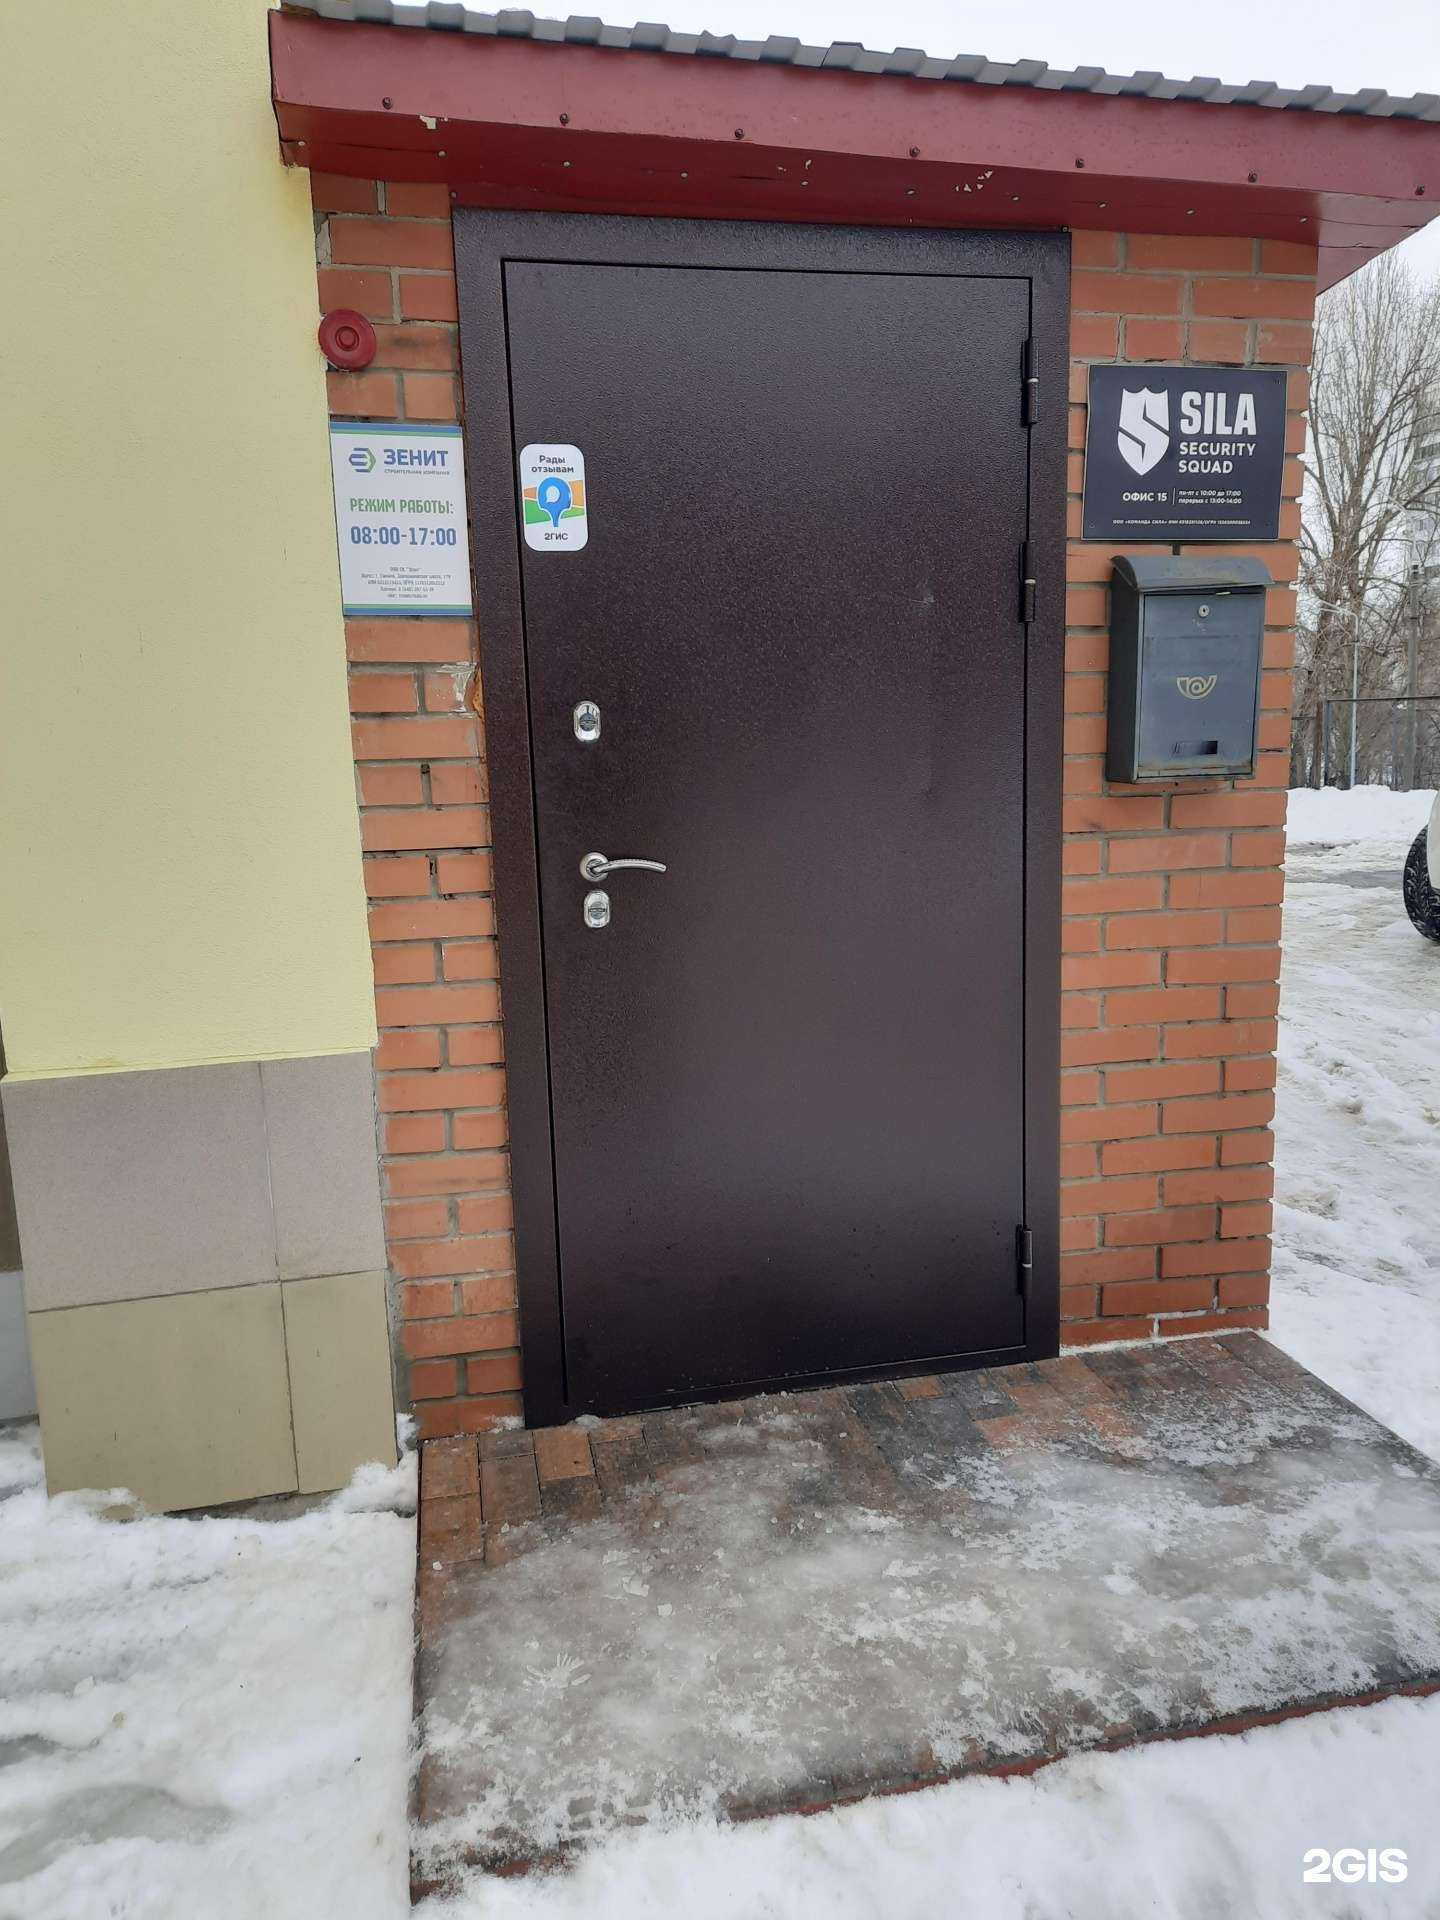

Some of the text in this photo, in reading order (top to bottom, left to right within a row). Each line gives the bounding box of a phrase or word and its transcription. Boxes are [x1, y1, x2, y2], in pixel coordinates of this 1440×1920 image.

[1180, 391, 1257, 436] SILA
[1179, 442, 1256, 456] SECURITY
[383, 448, 449, 467] ЗЕНИТ
[539, 455, 567, 464] Рады
[1178, 460, 1233, 474] SQUAD
[1122, 492, 1168, 502] ОФИС 15
[350, 498, 454, 514] РЕЖИМ РАБОТЫ:
[350, 526, 457, 546] 08:00-17:00
[544, 532, 569, 541] 2ГИС
